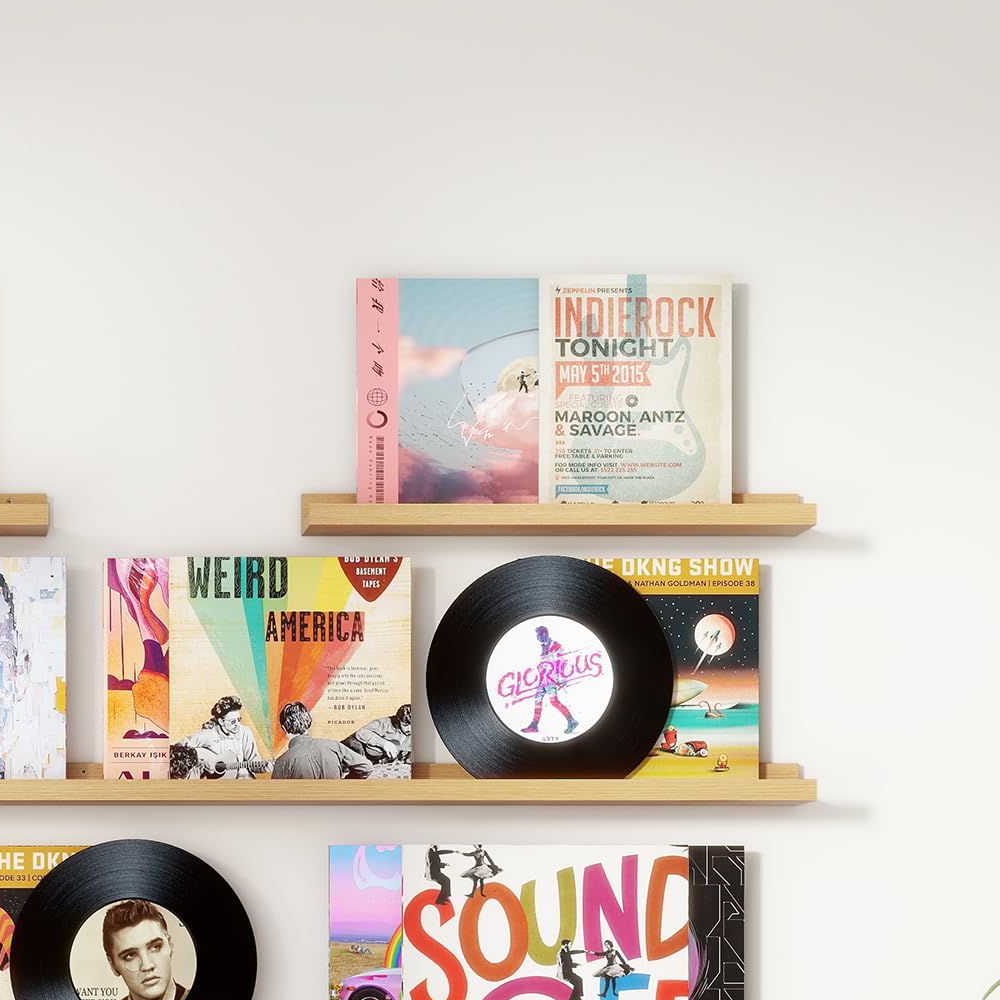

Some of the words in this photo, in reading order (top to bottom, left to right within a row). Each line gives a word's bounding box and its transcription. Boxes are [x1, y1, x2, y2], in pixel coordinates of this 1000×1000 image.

[555, 297, 716, 337] INDIEROCK
[555, 338, 674, 357] TONIGHT
[559, 364, 587, 383] MAY
[612, 364, 644, 383] 2015
[639, 411, 686, 423] ANTZ
[555, 424, 565, 436] &
[355, 567, 387, 575] BASEMENT
[622, 559, 681, 576] DKNG
[689, 559, 754, 576] SHOW
[187, 557, 289, 599] WEIRD
[362, 580, 380, 588] TAPES
[265, 611, 365, 642] AMERICA
[498, 652, 603, 697] GLORIOUS
[100, 987, 118, 996] YOU
